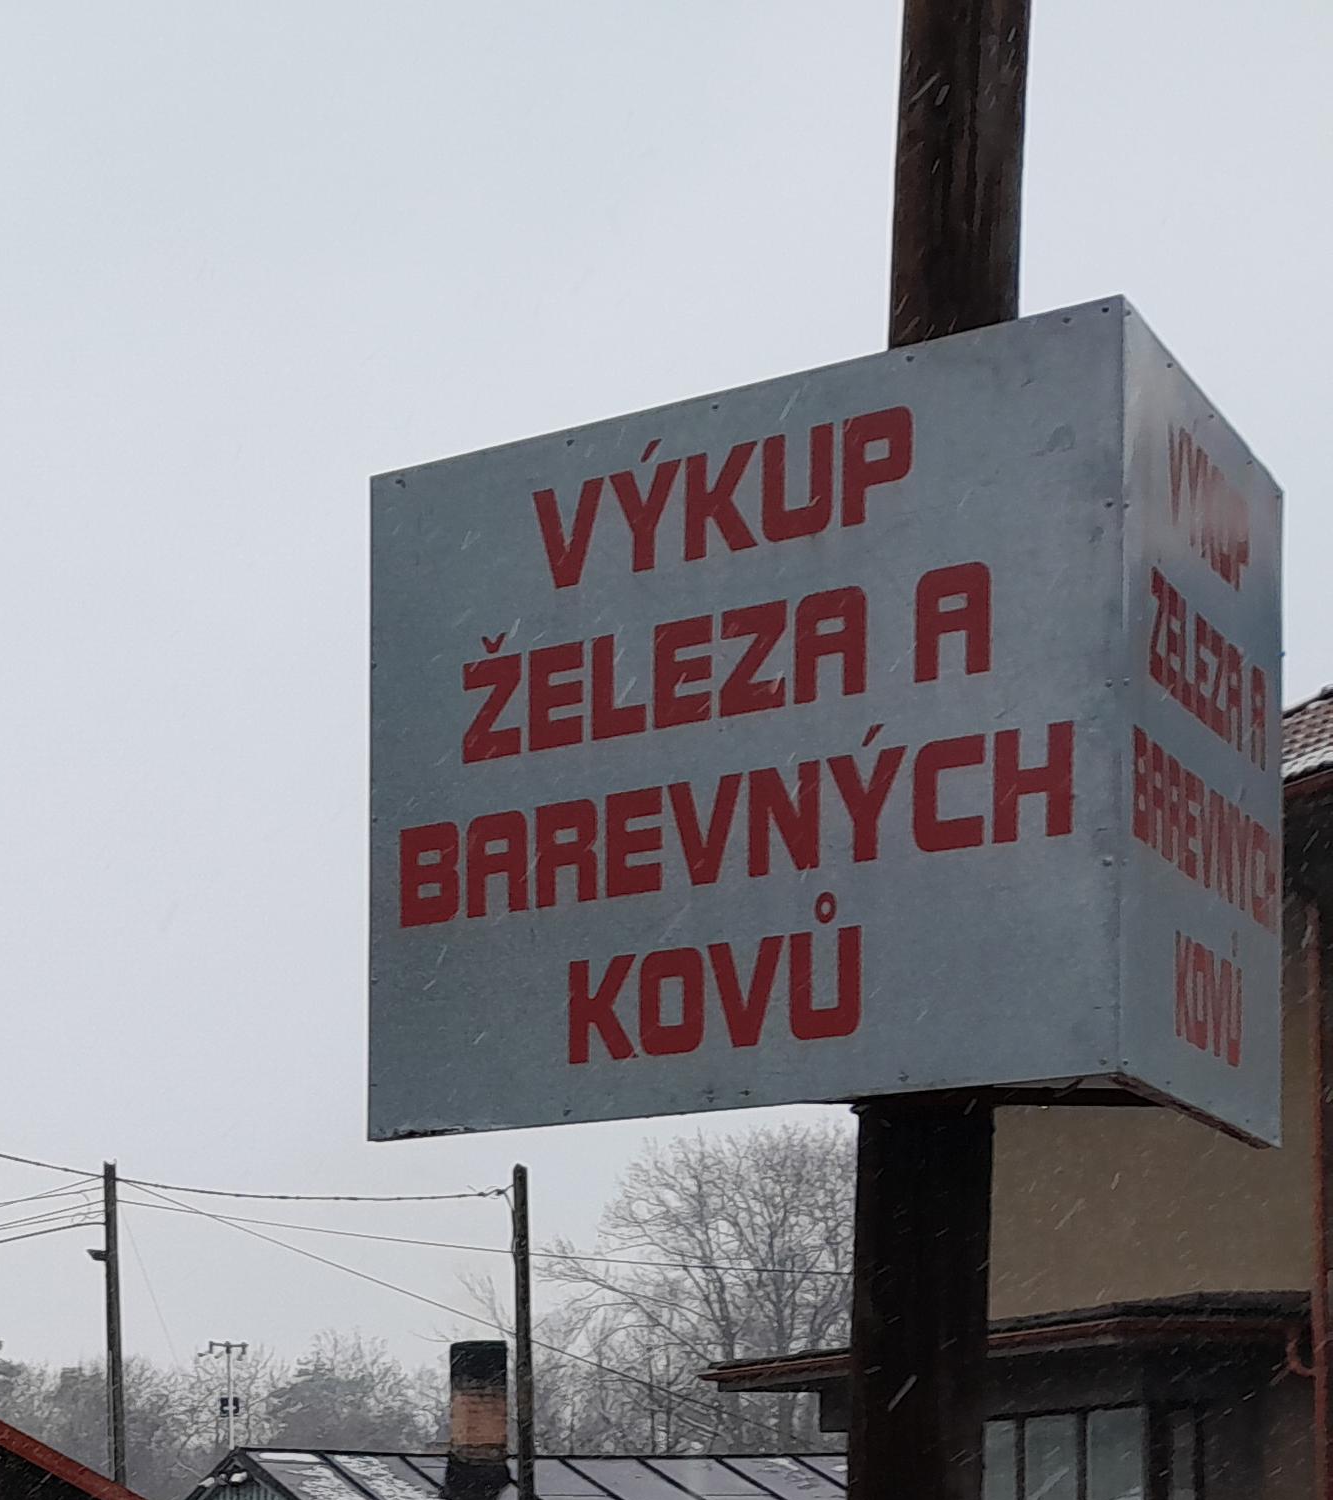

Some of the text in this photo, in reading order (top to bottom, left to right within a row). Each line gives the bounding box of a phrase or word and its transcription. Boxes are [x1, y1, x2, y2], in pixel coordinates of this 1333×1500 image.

[534, 405, 914, 589] VÝKUP
[462, 561, 992, 764] ŽELEZA A
[1250, 664, 1267, 773] A
[399, 722, 1075, 928] BAREVNÝCH
[568, 891, 863, 1064] KOVŮ
